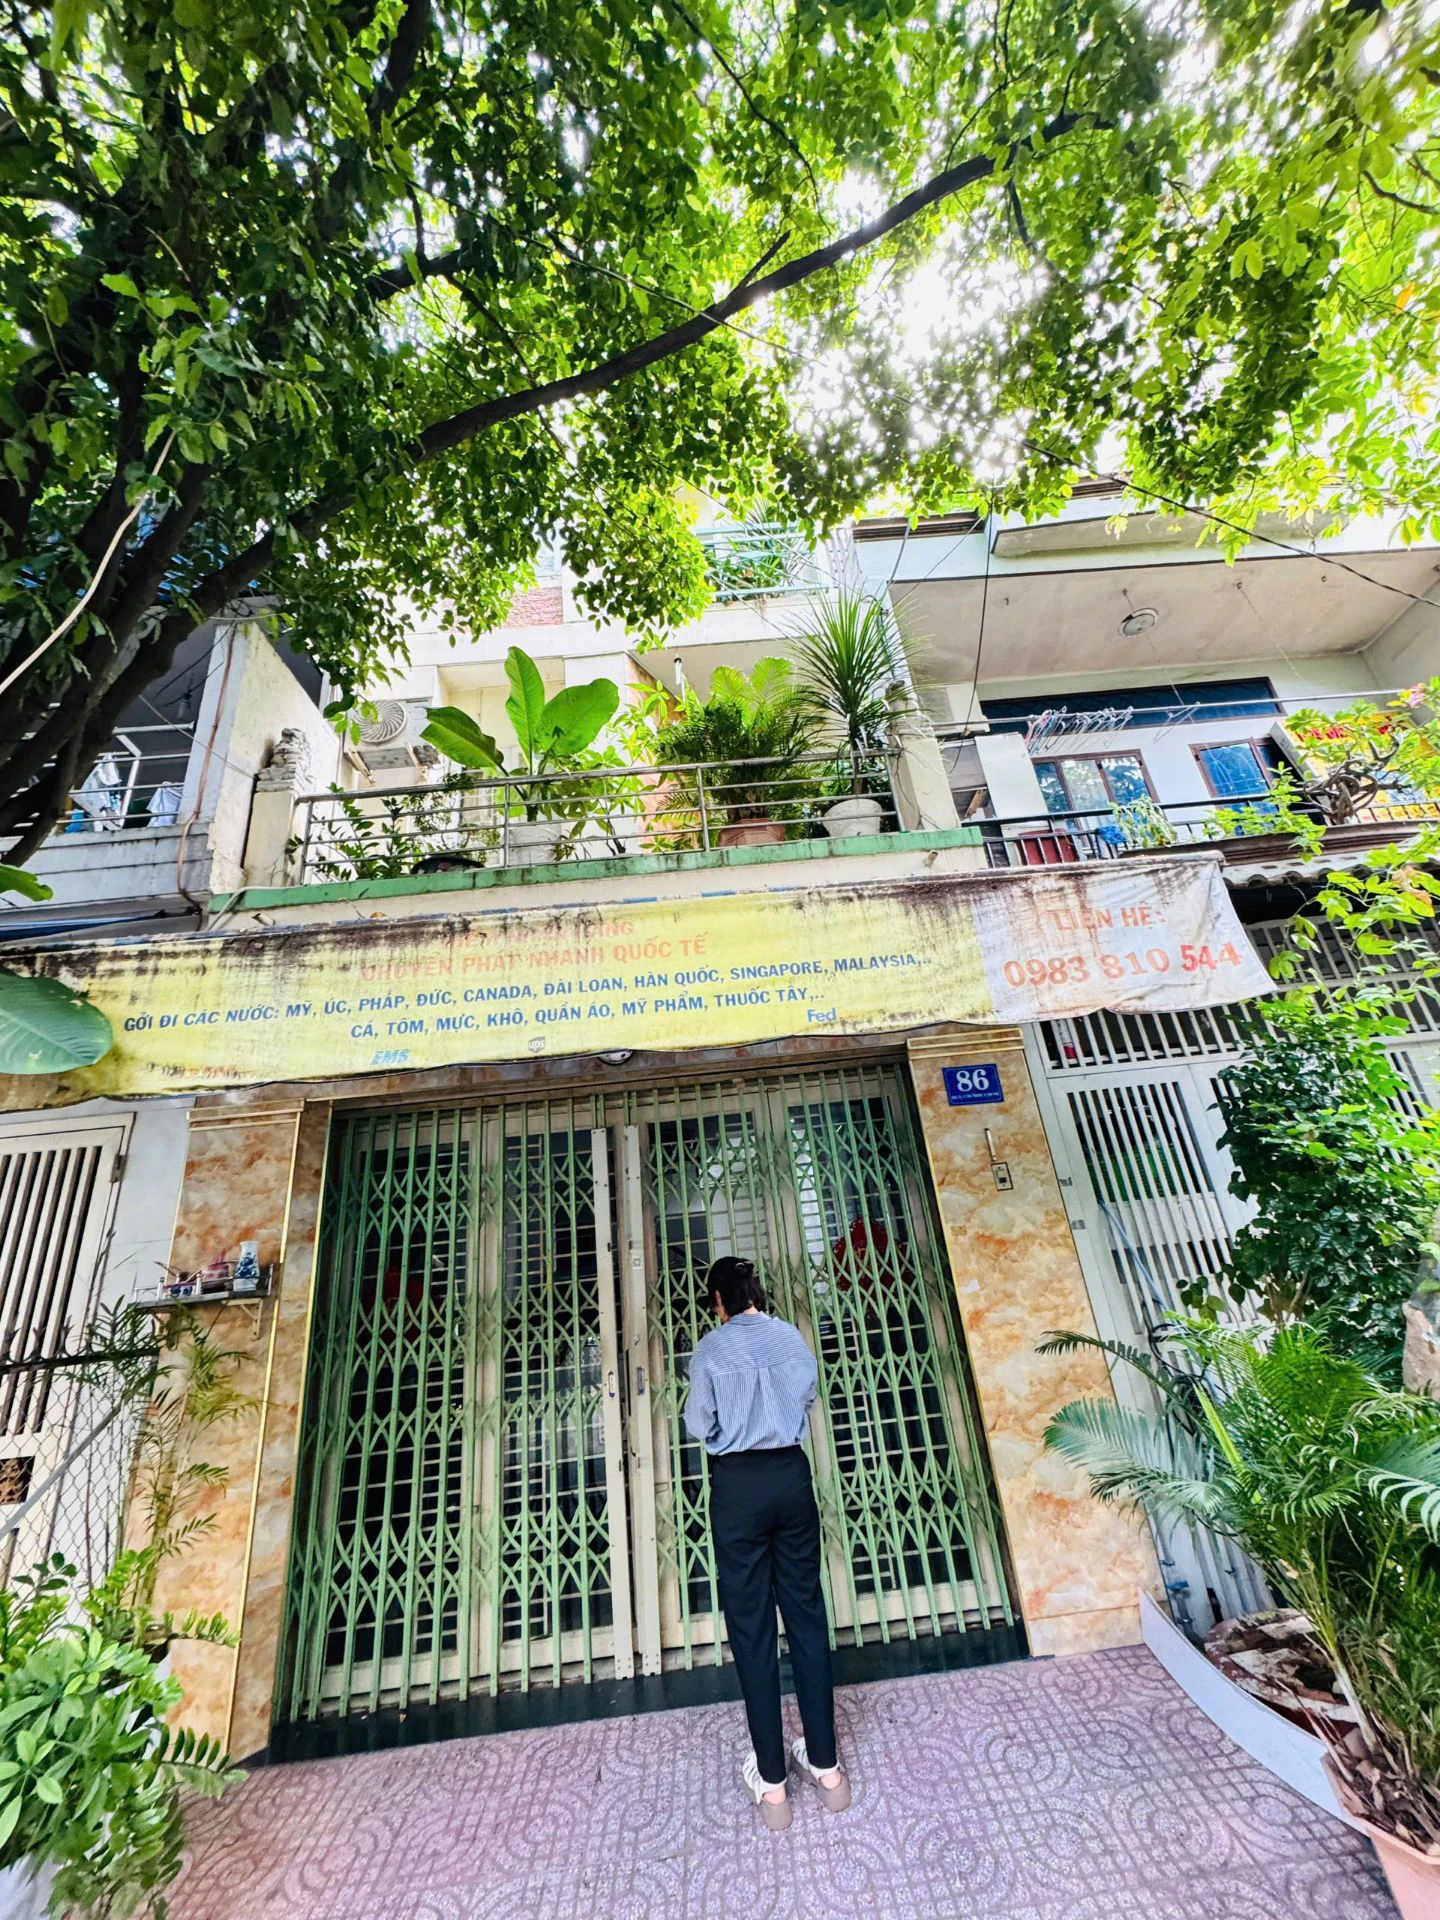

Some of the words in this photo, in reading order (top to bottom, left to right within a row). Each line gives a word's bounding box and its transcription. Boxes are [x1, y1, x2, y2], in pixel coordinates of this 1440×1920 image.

[529, 946, 604, 969] NHANH
[613, 935, 672, 964] QUỐC
[680, 931, 709, 956] TẾ
[1003, 955, 1089, 987] 0983
[1100, 948, 1171, 979] 810
[1180, 941, 1241, 972] 544
[159, 1014, 179, 1028] ĐI
[183, 1009, 219, 1026] CÁC
[226, 1004, 279, 1022] NƯỚC:
[286, 1000, 317, 1018] MỸ,
[324, 997, 351, 1015] ÚC,
[358, 992, 409, 1011] PHÁP,
[416, 988, 457, 1006] ĐỨC,
[463, 984, 537, 1002] CANADA,
[544, 979, 572, 995] ĐÀI
[578, 977, 628, 993] LOAN,
[634, 970, 668, 989] HÀN
[675, 965, 724, 987] QUỐC,
[730, 960, 829, 981] SINGAPORE,
[351, 1020, 379, 1039] CÁ,
[386, 1017, 429, 1036] TÔM,
[436, 1014, 480, 1034] MỰC,
[487, 1008, 528, 1027] KHÔ,
[535, 1002, 581, 1025] QUẦN
[588, 1001, 615, 1018] ÁO,
[622, 998, 647, 1016] MỸ
[654, 991, 708, 1013] PHẨM,
[714, 985, 771, 1009] THUỐC
[370, 1048, 410, 1066] EMS
[956, 1068, 989, 1092] 86
